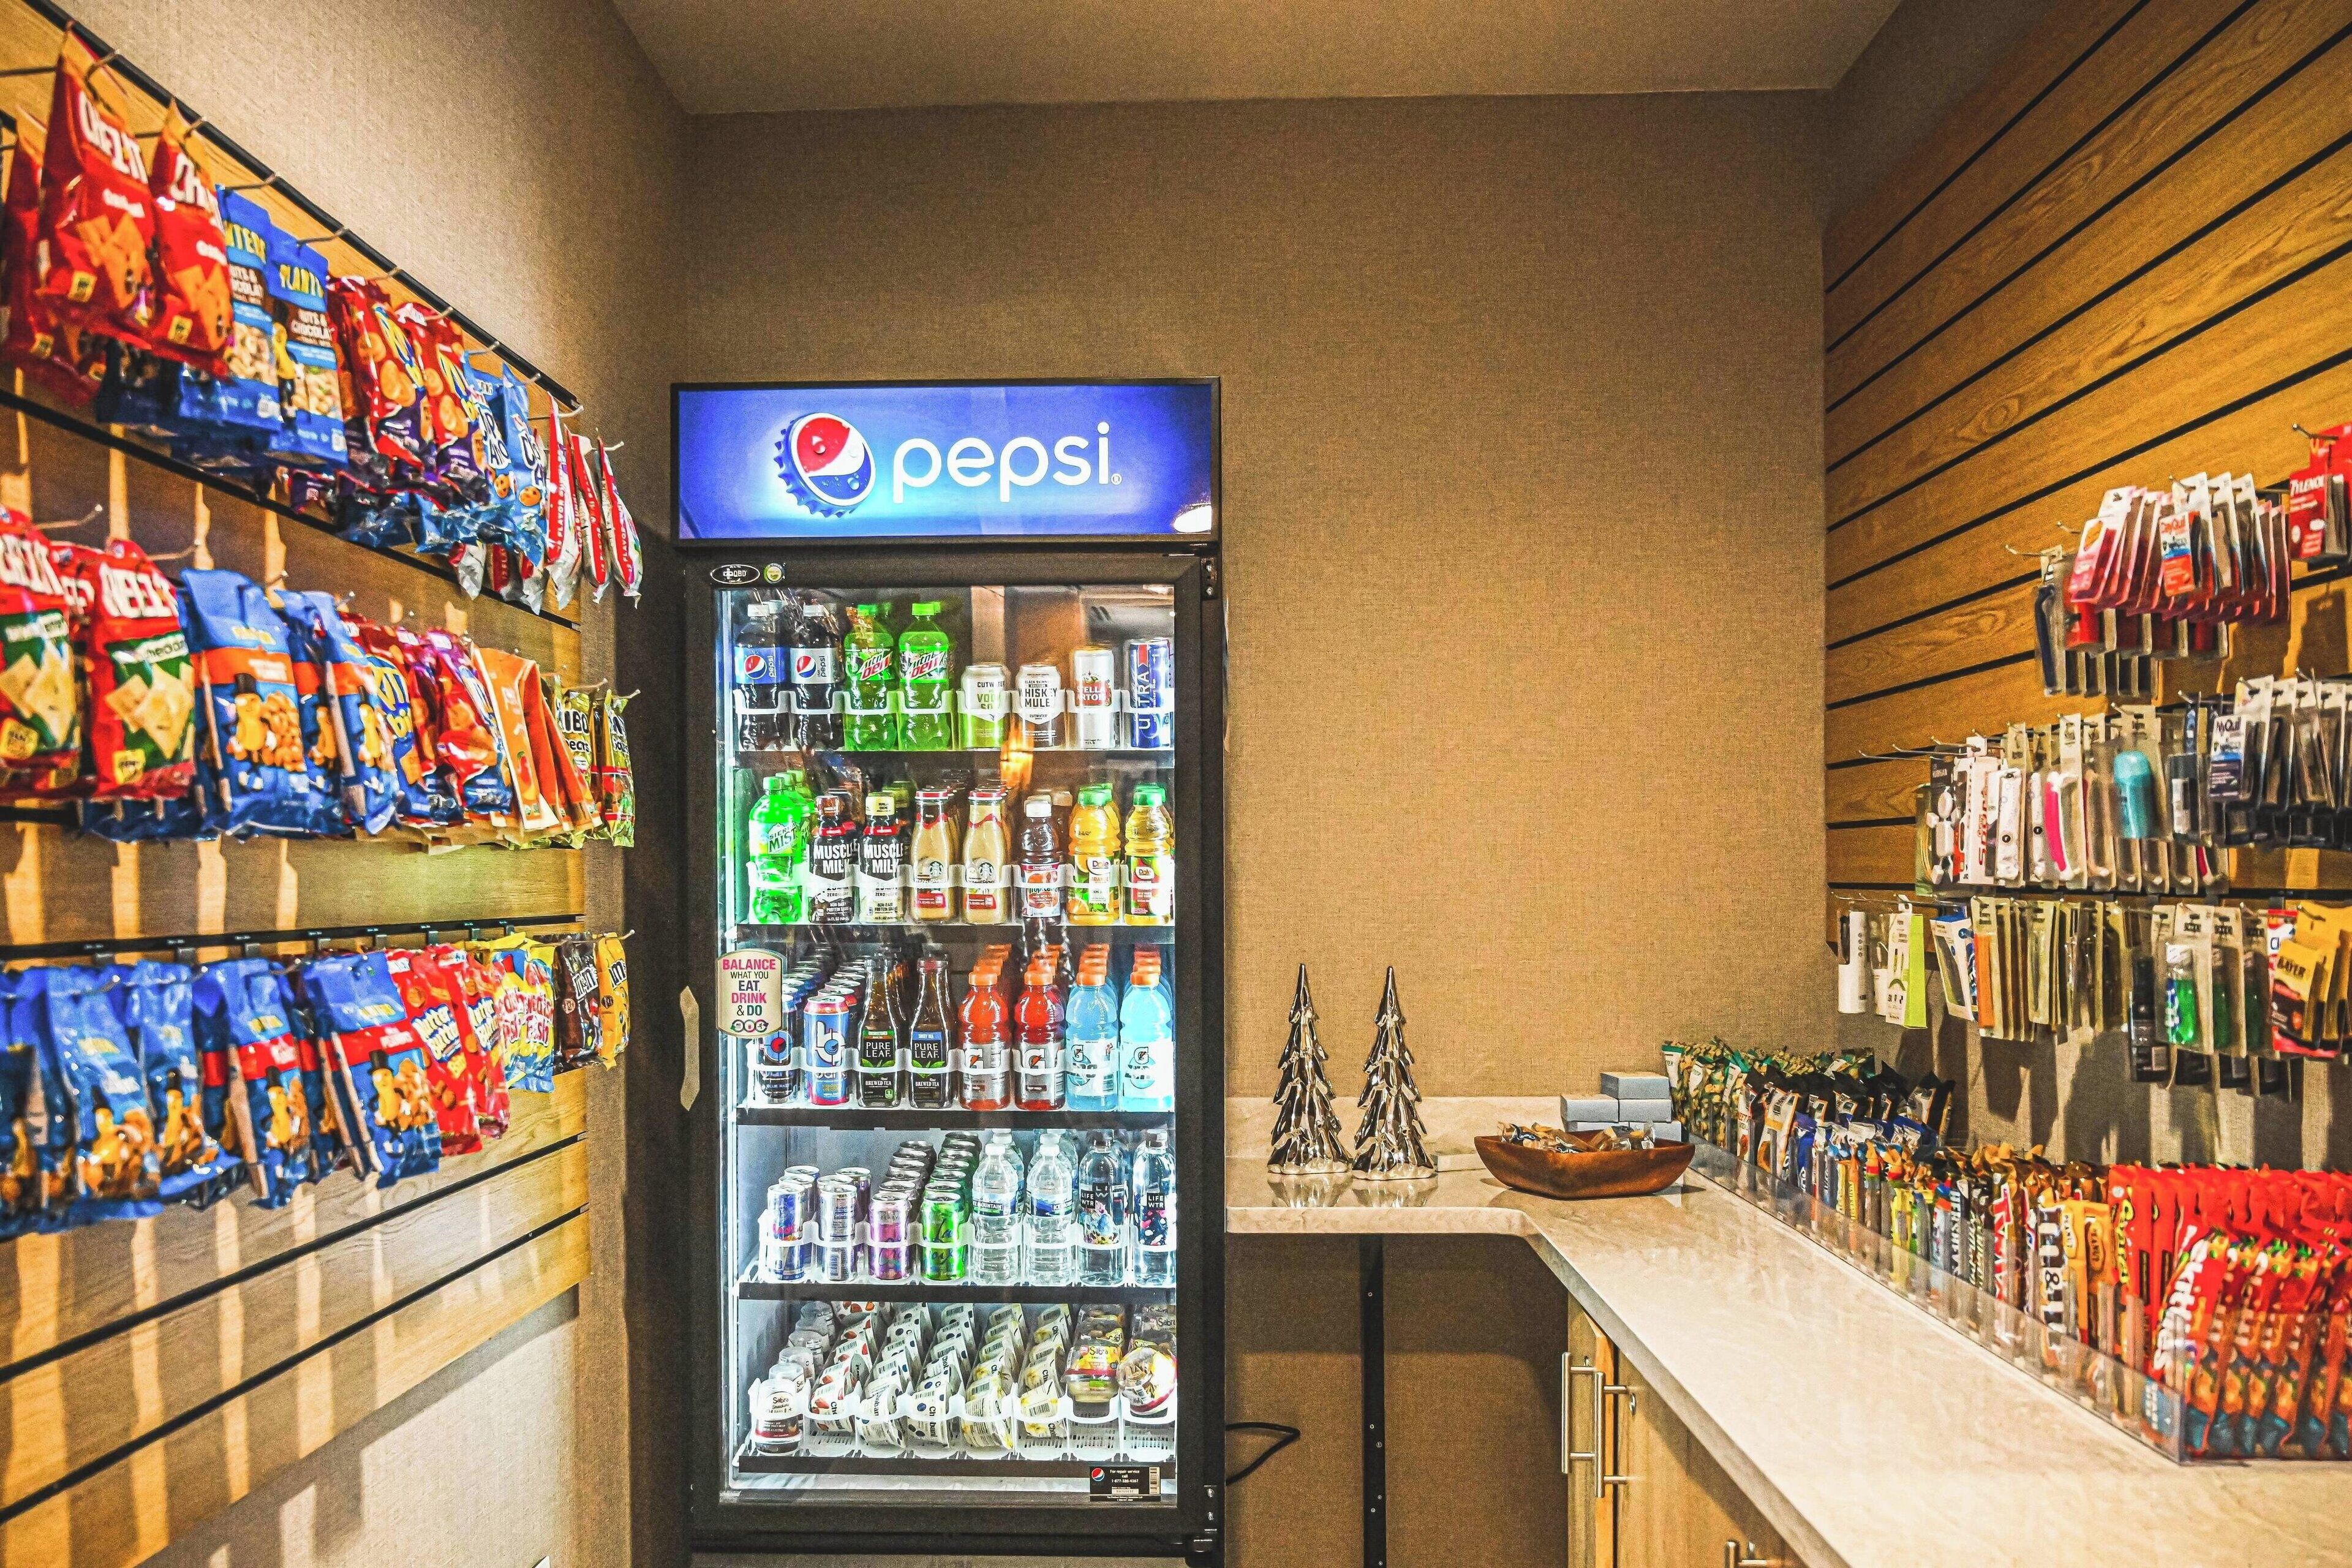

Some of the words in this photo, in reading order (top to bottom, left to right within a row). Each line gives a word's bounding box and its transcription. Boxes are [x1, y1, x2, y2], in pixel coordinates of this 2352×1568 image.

[893, 421, 1110, 503] pepsi
[767, 655, 777, 677] pepsi
[1019, 688, 1057, 698] WHISKY
[1025, 698, 1050, 707] MULE
[1137, 671, 1152, 729] UTRA
[769, 828, 796, 853] MIST
[722, 959, 776, 970] BALANCE
[731, 992, 767, 1003] DRINK
[737, 1005, 744, 1016] &
[747, 1005, 763, 1016] DO
[2153, 1238, 2210, 1370] Skittles
[1158, 1317, 1175, 1327] Sabra
[1089, 1346, 1109, 1355] Sabra
[929, 1406, 938, 1438] Chbani
